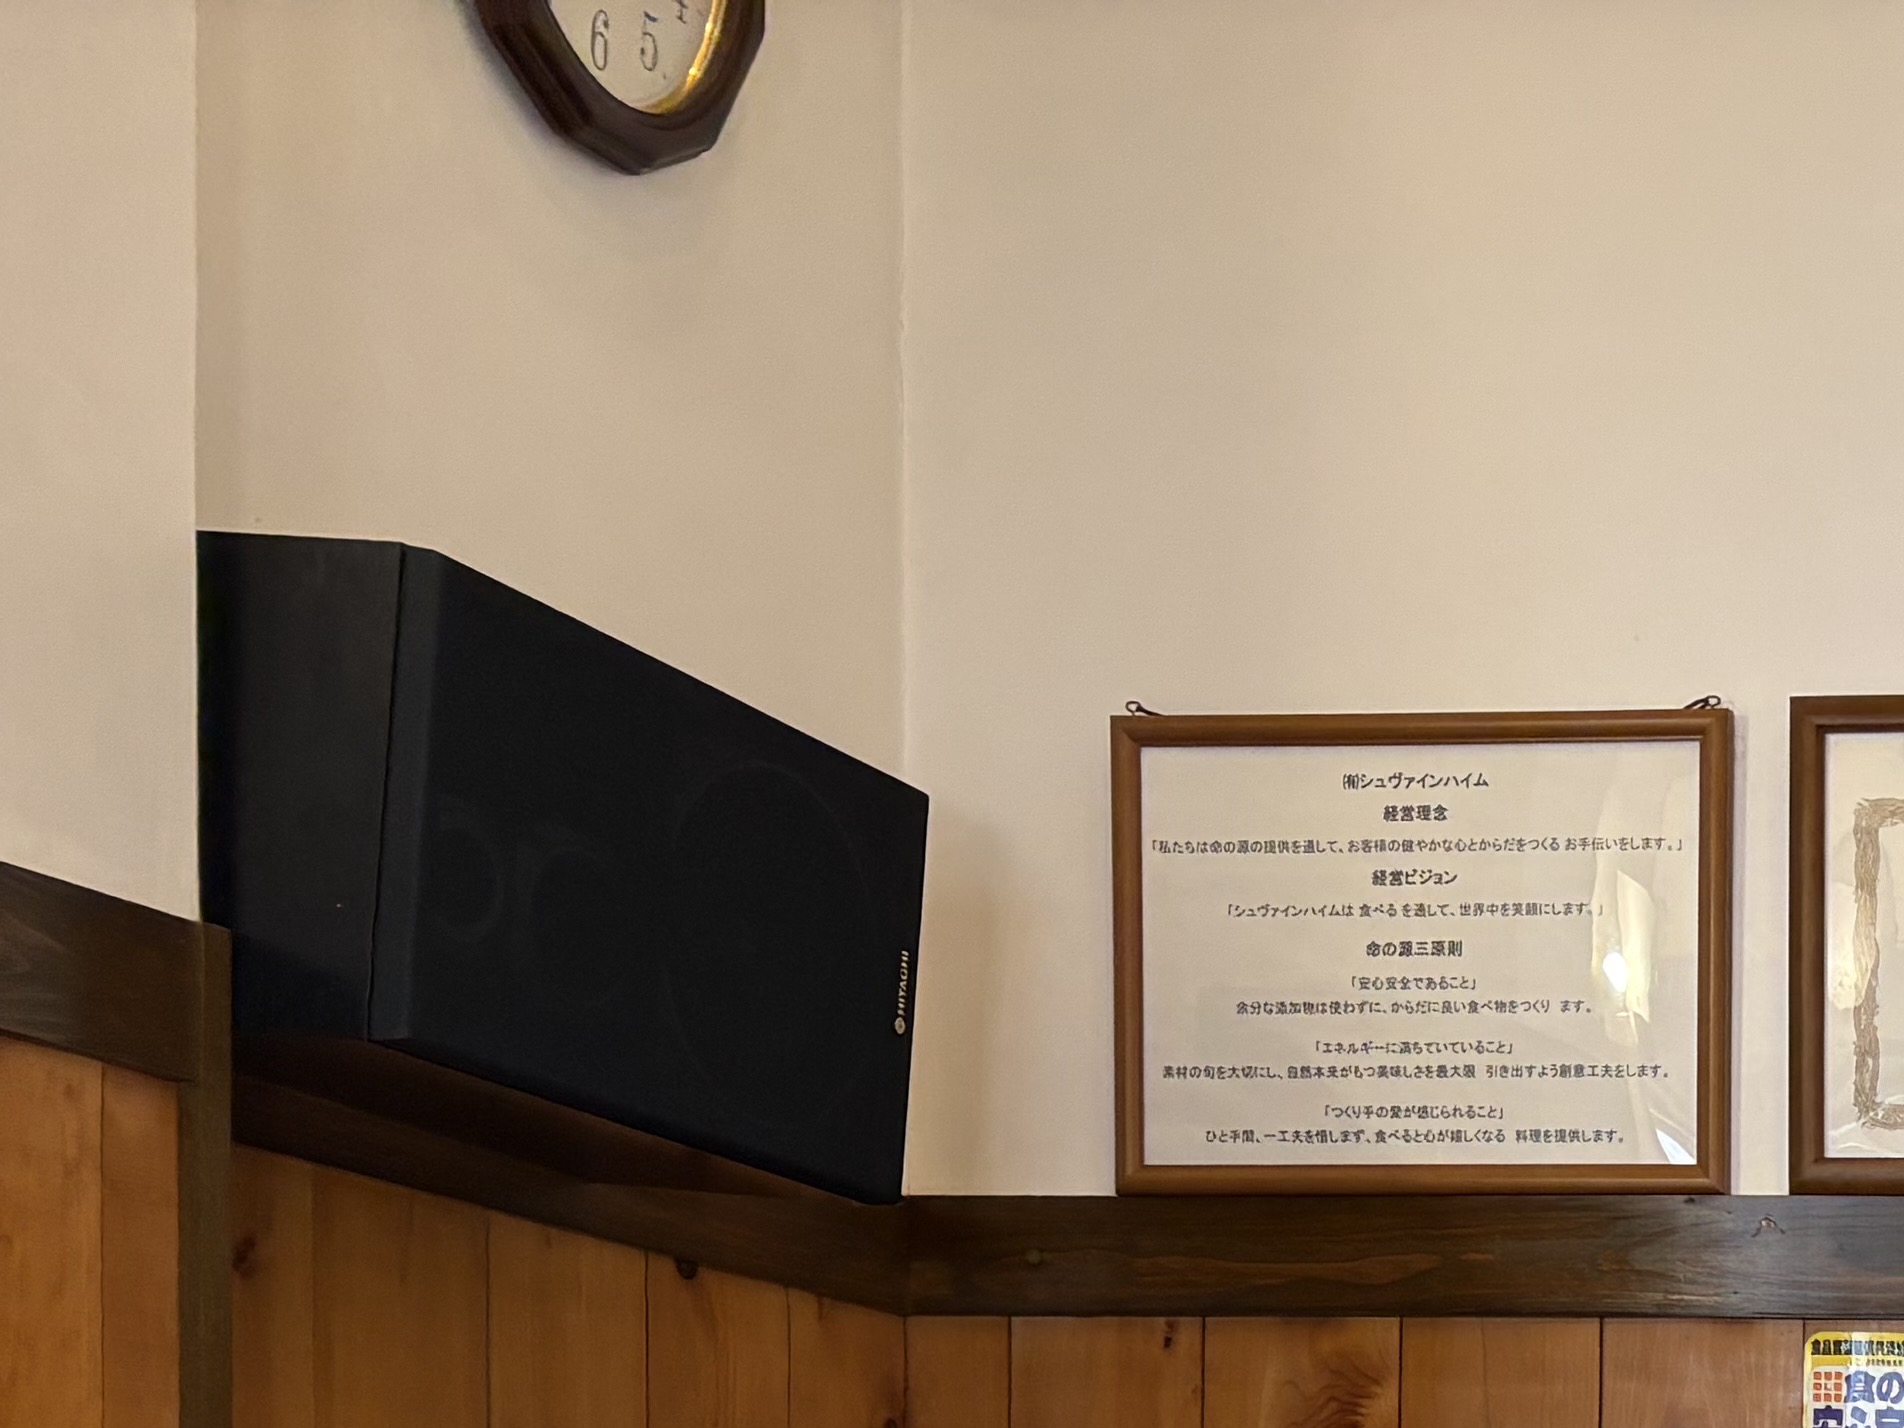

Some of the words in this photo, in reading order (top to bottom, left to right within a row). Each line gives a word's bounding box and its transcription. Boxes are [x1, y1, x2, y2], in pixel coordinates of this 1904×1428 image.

[1382, 804, 1450, 822] 経営理念
[1371, 869, 1458, 887] 経営ビジョン
